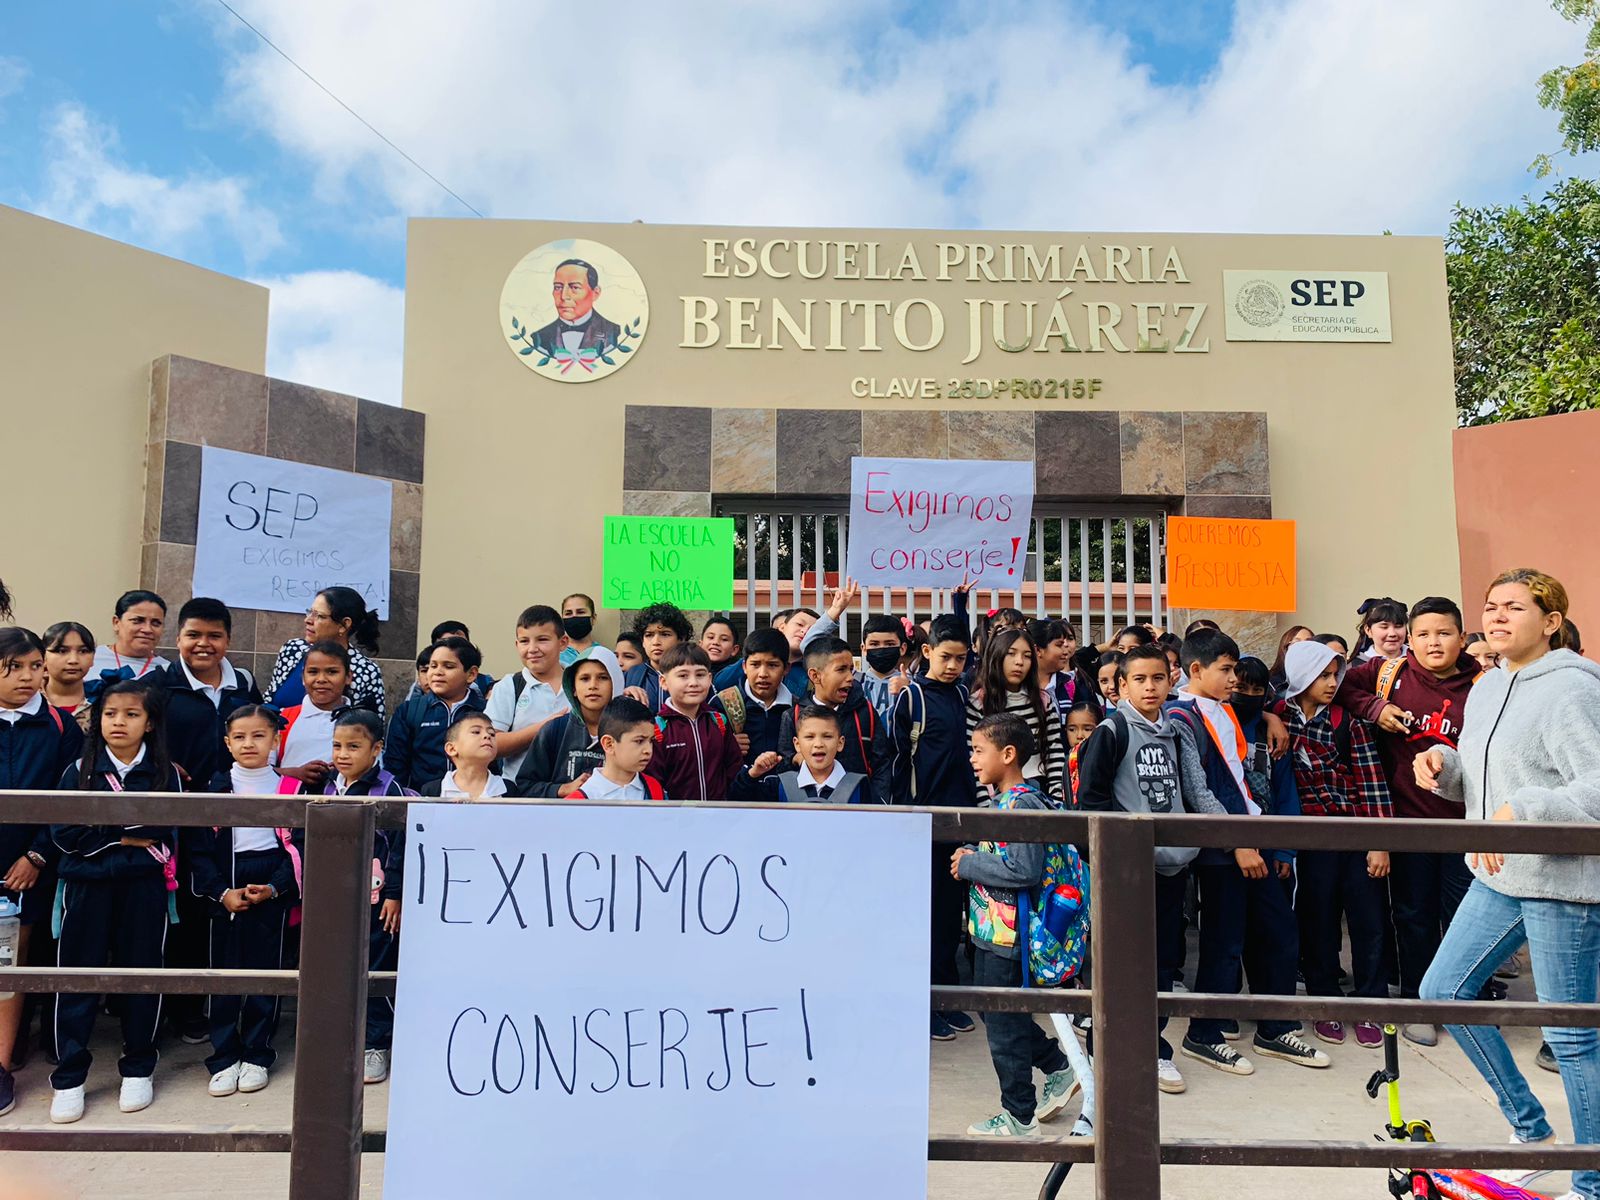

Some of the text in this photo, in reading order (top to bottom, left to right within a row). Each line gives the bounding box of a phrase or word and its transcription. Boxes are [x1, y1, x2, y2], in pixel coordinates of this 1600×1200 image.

[702, 238, 1192, 285] ESCUELA PRIMARIA
[1290, 279, 1366, 307] SEP
[678, 296, 945, 351] BENITO
[961, 286, 1211, 365] JUÁREZ
[1345, 317, 1357, 325] DE
[850, 377, 1103, 400] CLAVE: 25DPR0215F
[225, 481, 319, 539] SEP
[865, 471, 1013, 533] Exigimos
[610, 522, 716, 547] LA ESCUELA
[1176, 521, 1262, 548] QUEREMOS
[243, 547, 345, 571] EXIGIMOS
[650, 549, 680, 573] NO
[1174, 553, 1289, 589] RESPUESTA
[609, 576, 706, 603] SE ABRIRÁ
[1139, 747, 1165, 764] NYC
[1137, 763, 1169, 776] BRKLYN
[416, 823, 791, 942] ¡EXIGIMOS
[447, 988, 817, 1097] CONSERJE!
